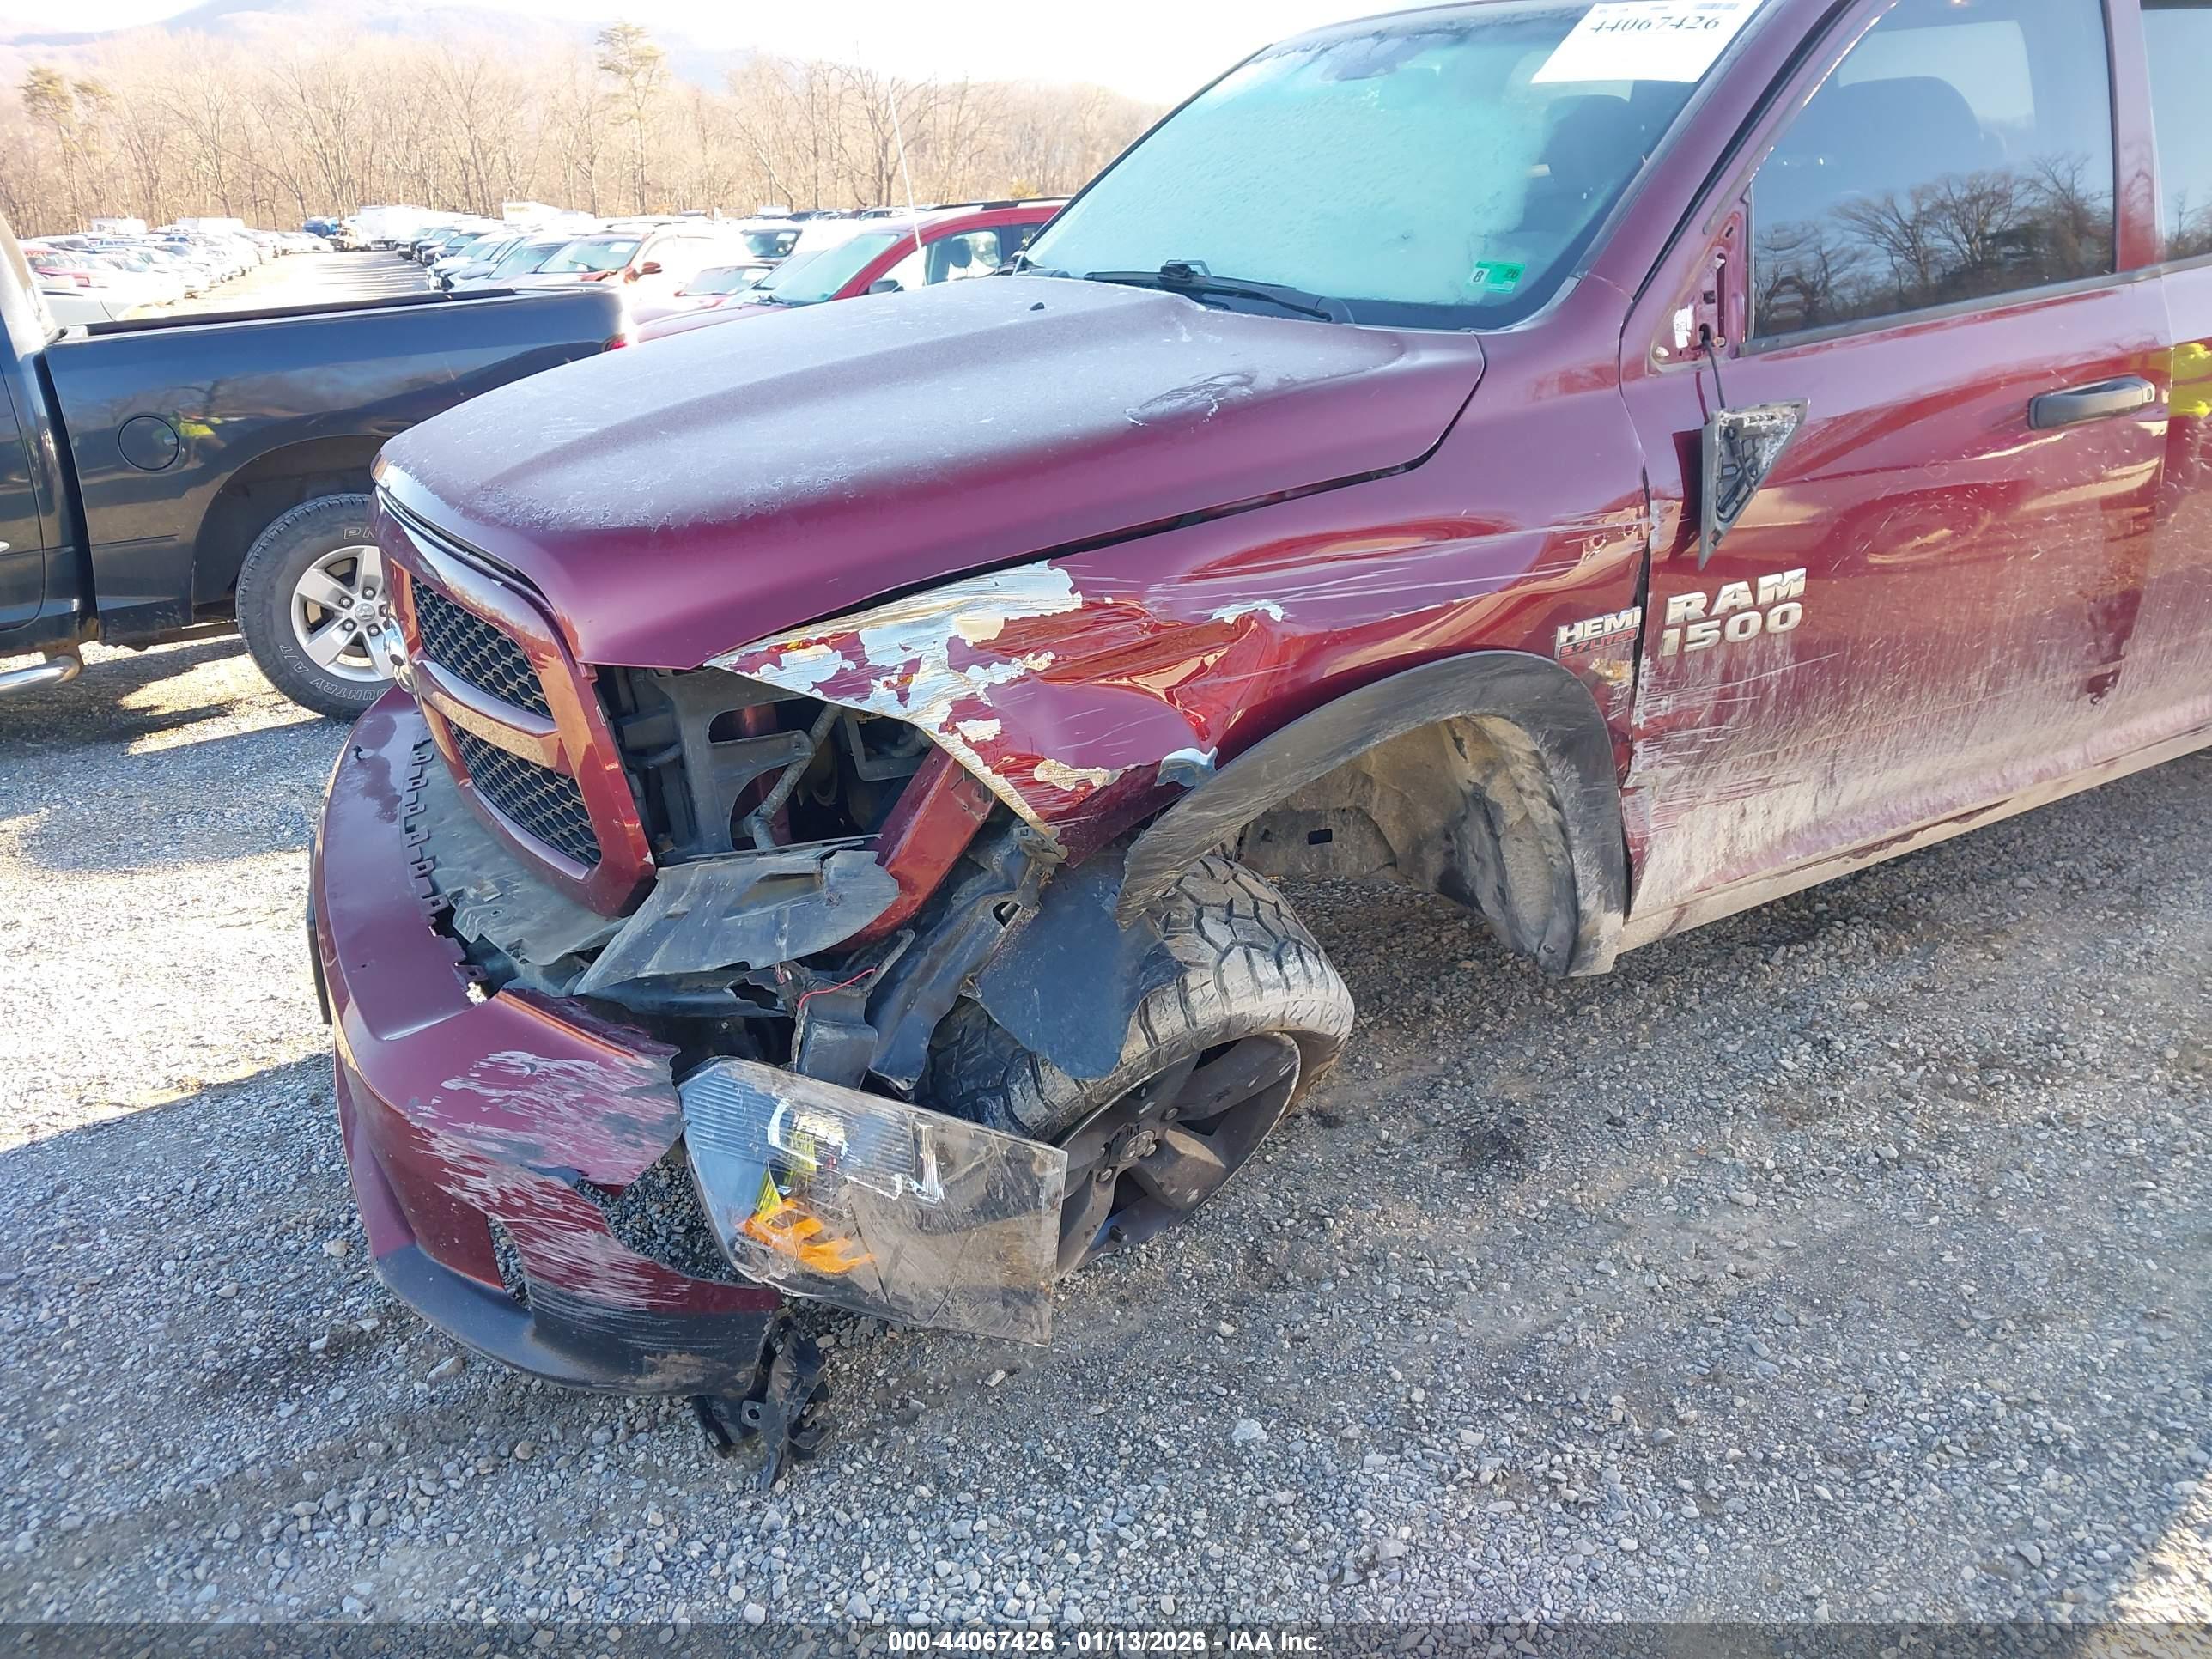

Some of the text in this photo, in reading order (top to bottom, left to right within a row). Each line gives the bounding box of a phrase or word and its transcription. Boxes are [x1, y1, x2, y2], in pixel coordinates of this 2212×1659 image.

[1589, 15, 1720, 33] 44067426
[1473, 270, 1485, 283] 8
[1664, 567, 1807, 626] RAM
[1557, 605, 1642, 645] HEMI
[1662, 602, 1803, 658] 1500
[1559, 629, 1637, 657] 5.7 LITER
